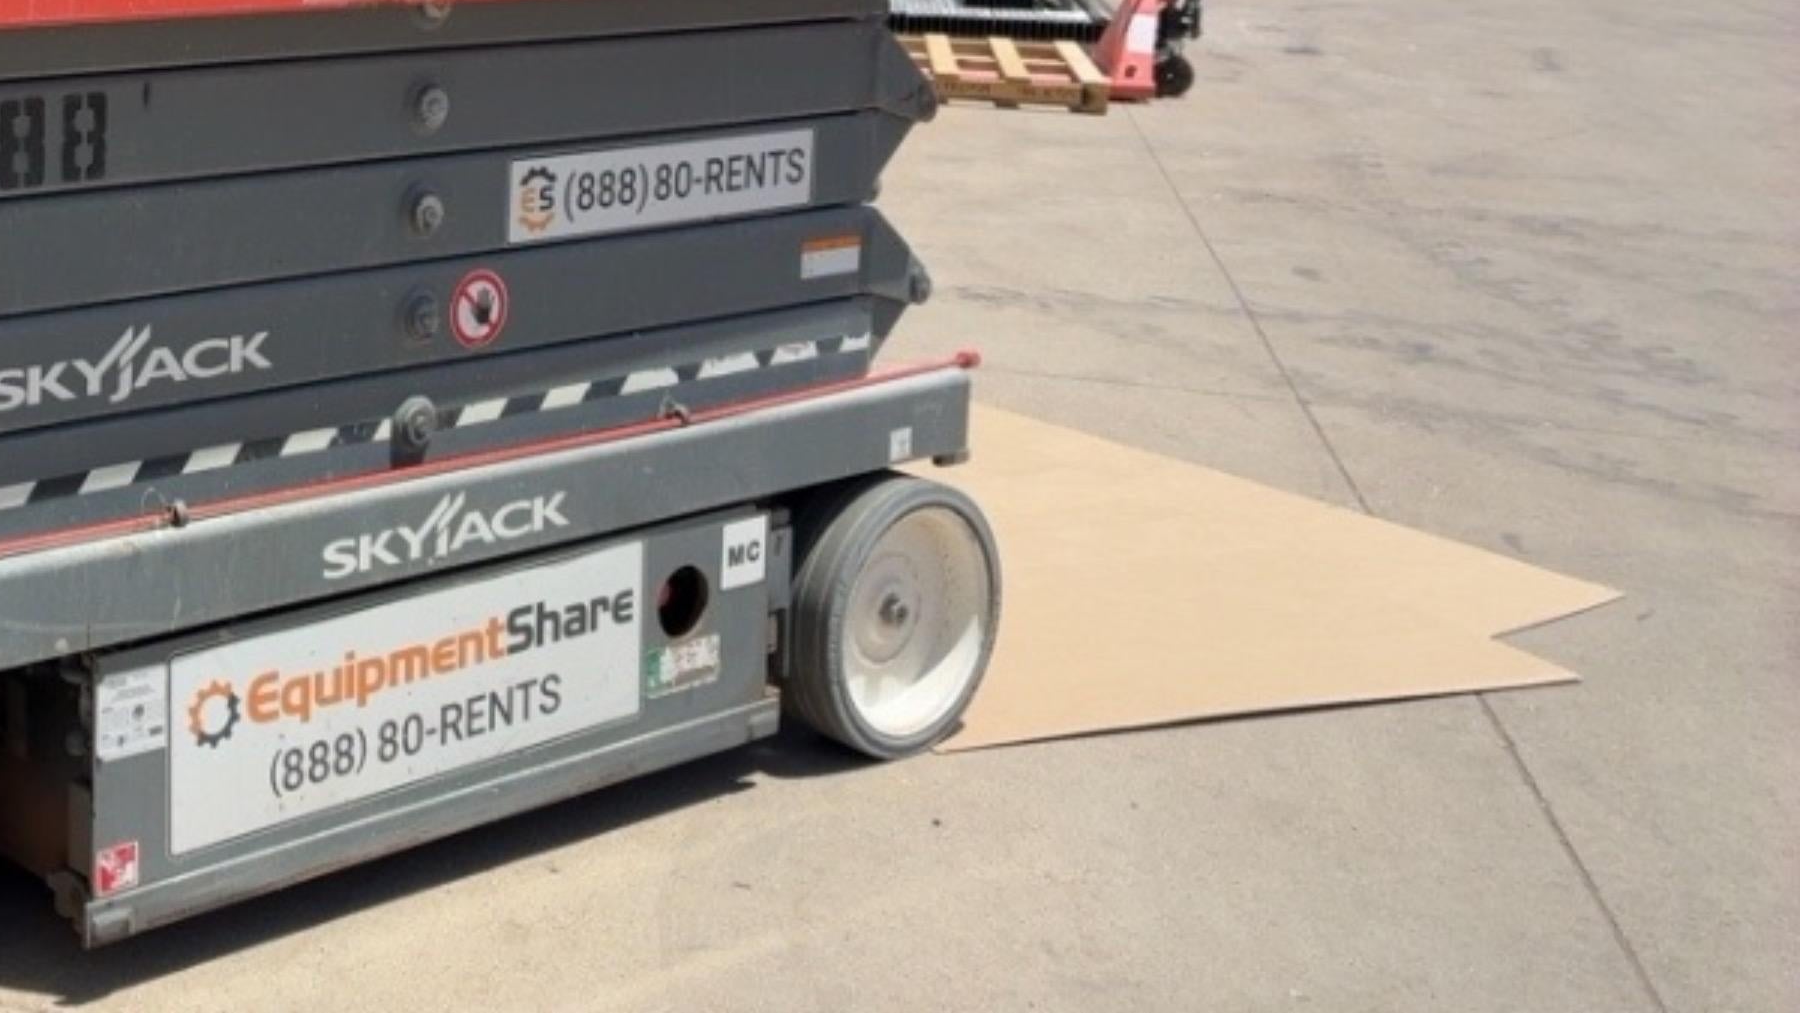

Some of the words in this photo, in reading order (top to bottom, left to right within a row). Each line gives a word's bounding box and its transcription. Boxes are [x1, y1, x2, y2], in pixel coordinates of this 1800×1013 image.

[322, 490, 571, 580] SKYJACK
[727, 540, 761, 569] MC
[246, 588, 634, 723] EquipmentShare
[269, 727, 369, 799] (888)
[377, 672, 563, 764] 80-RENTS
